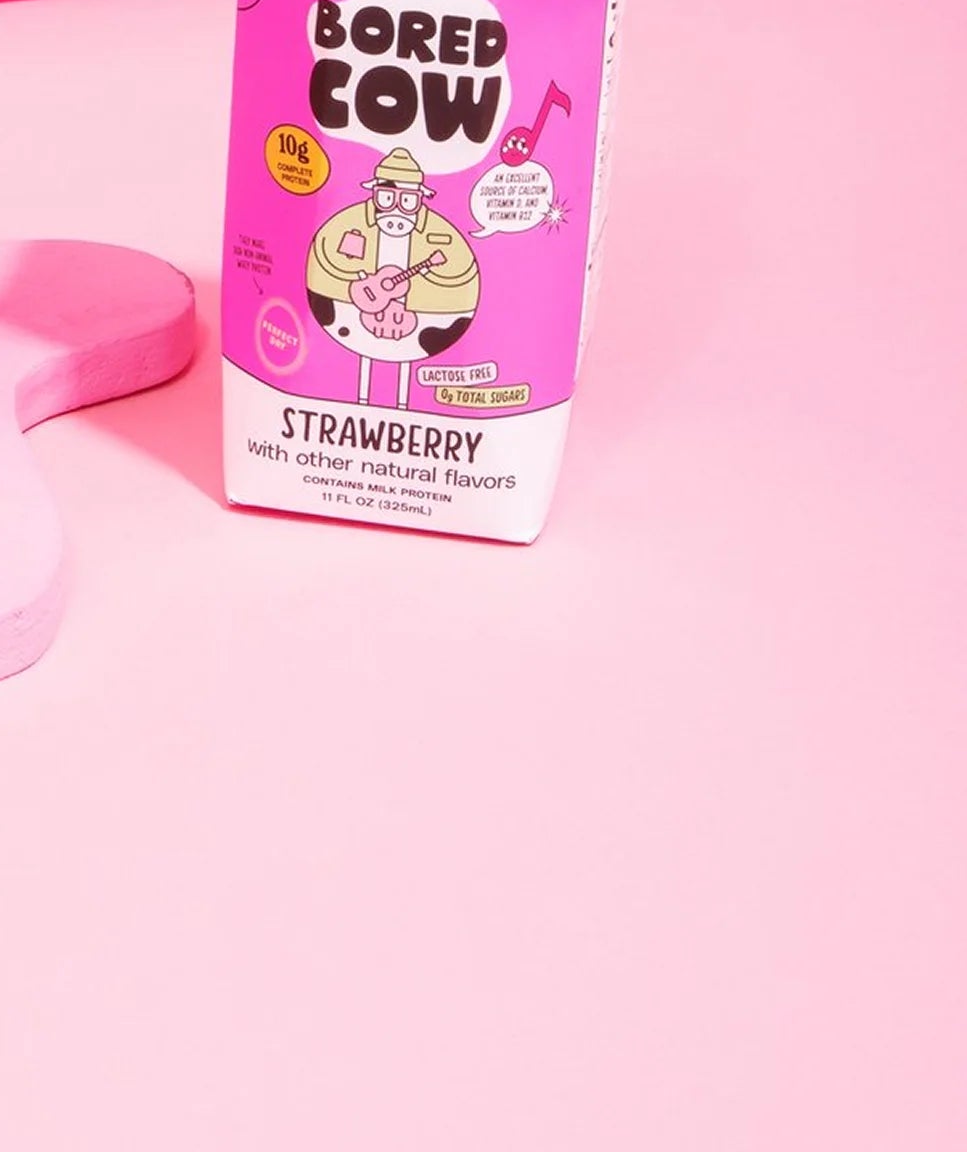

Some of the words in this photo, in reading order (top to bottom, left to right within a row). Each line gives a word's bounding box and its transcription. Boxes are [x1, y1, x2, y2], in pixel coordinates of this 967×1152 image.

[309, 58, 502, 144] COW
[279, 133, 310, 164] 10g
[277, 162, 312, 177] COMPLETE
[506, 172, 540, 183] EXCELLENT
[282, 173, 310, 186] PROTEIN
[480, 186, 506, 196] SOURCE
[508, 186, 517, 196] OF
[487, 198, 514, 208] VITAMIN
[525, 198, 539, 208] AND
[489, 211, 517, 221] VITAMIN
[262, 319, 298, 346] PERFECT
[423, 370, 465, 382] LACTOSE
[470, 366, 491, 381] FREE
[441, 389, 453, 402] 0g
[457, 390, 486, 403] TOTAL
[491, 389, 526, 403] SUGARS
[281, 407, 483, 464] STRAWBERRY
[248, 438, 288, 463] with
[296, 451, 353, 471] other
[362, 460, 436, 483] natural
[444, 468, 516, 489] flavors
[303, 475, 364, 490] CONTAINS
[367, 484, 396, 495] MILK
[401, 488, 452, 503] PROTEIN
[322, 493, 332, 503] 11
[337, 494, 352, 504] FL
[356, 496, 375, 508] OZ
[378, 499, 432, 516] (325mL)
